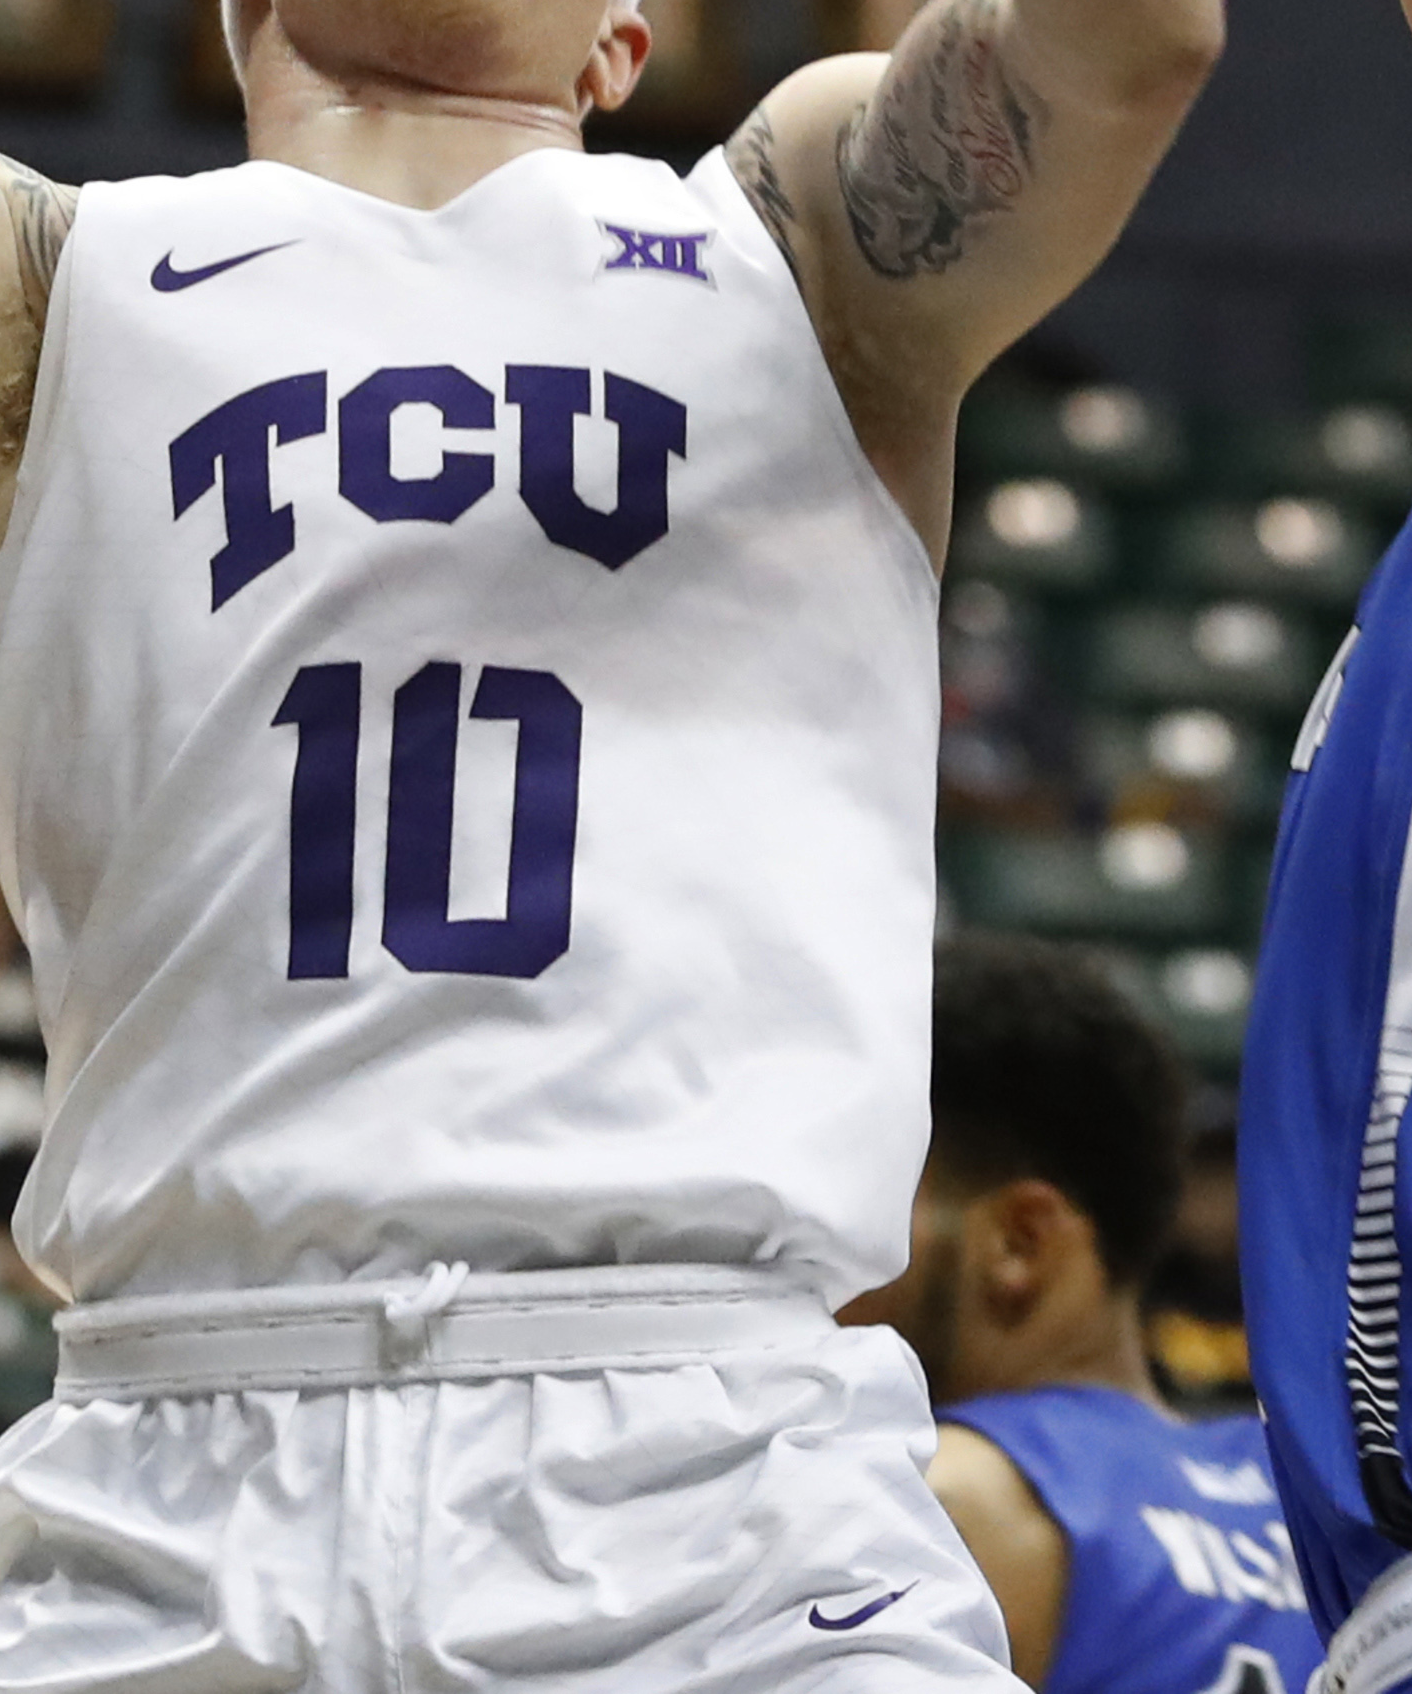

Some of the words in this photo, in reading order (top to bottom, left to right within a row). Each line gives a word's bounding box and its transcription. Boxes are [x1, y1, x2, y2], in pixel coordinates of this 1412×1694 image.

[603, 221, 710, 282] XII
[168, 362, 688, 615] TCU
[270, 660, 584, 982] 10
